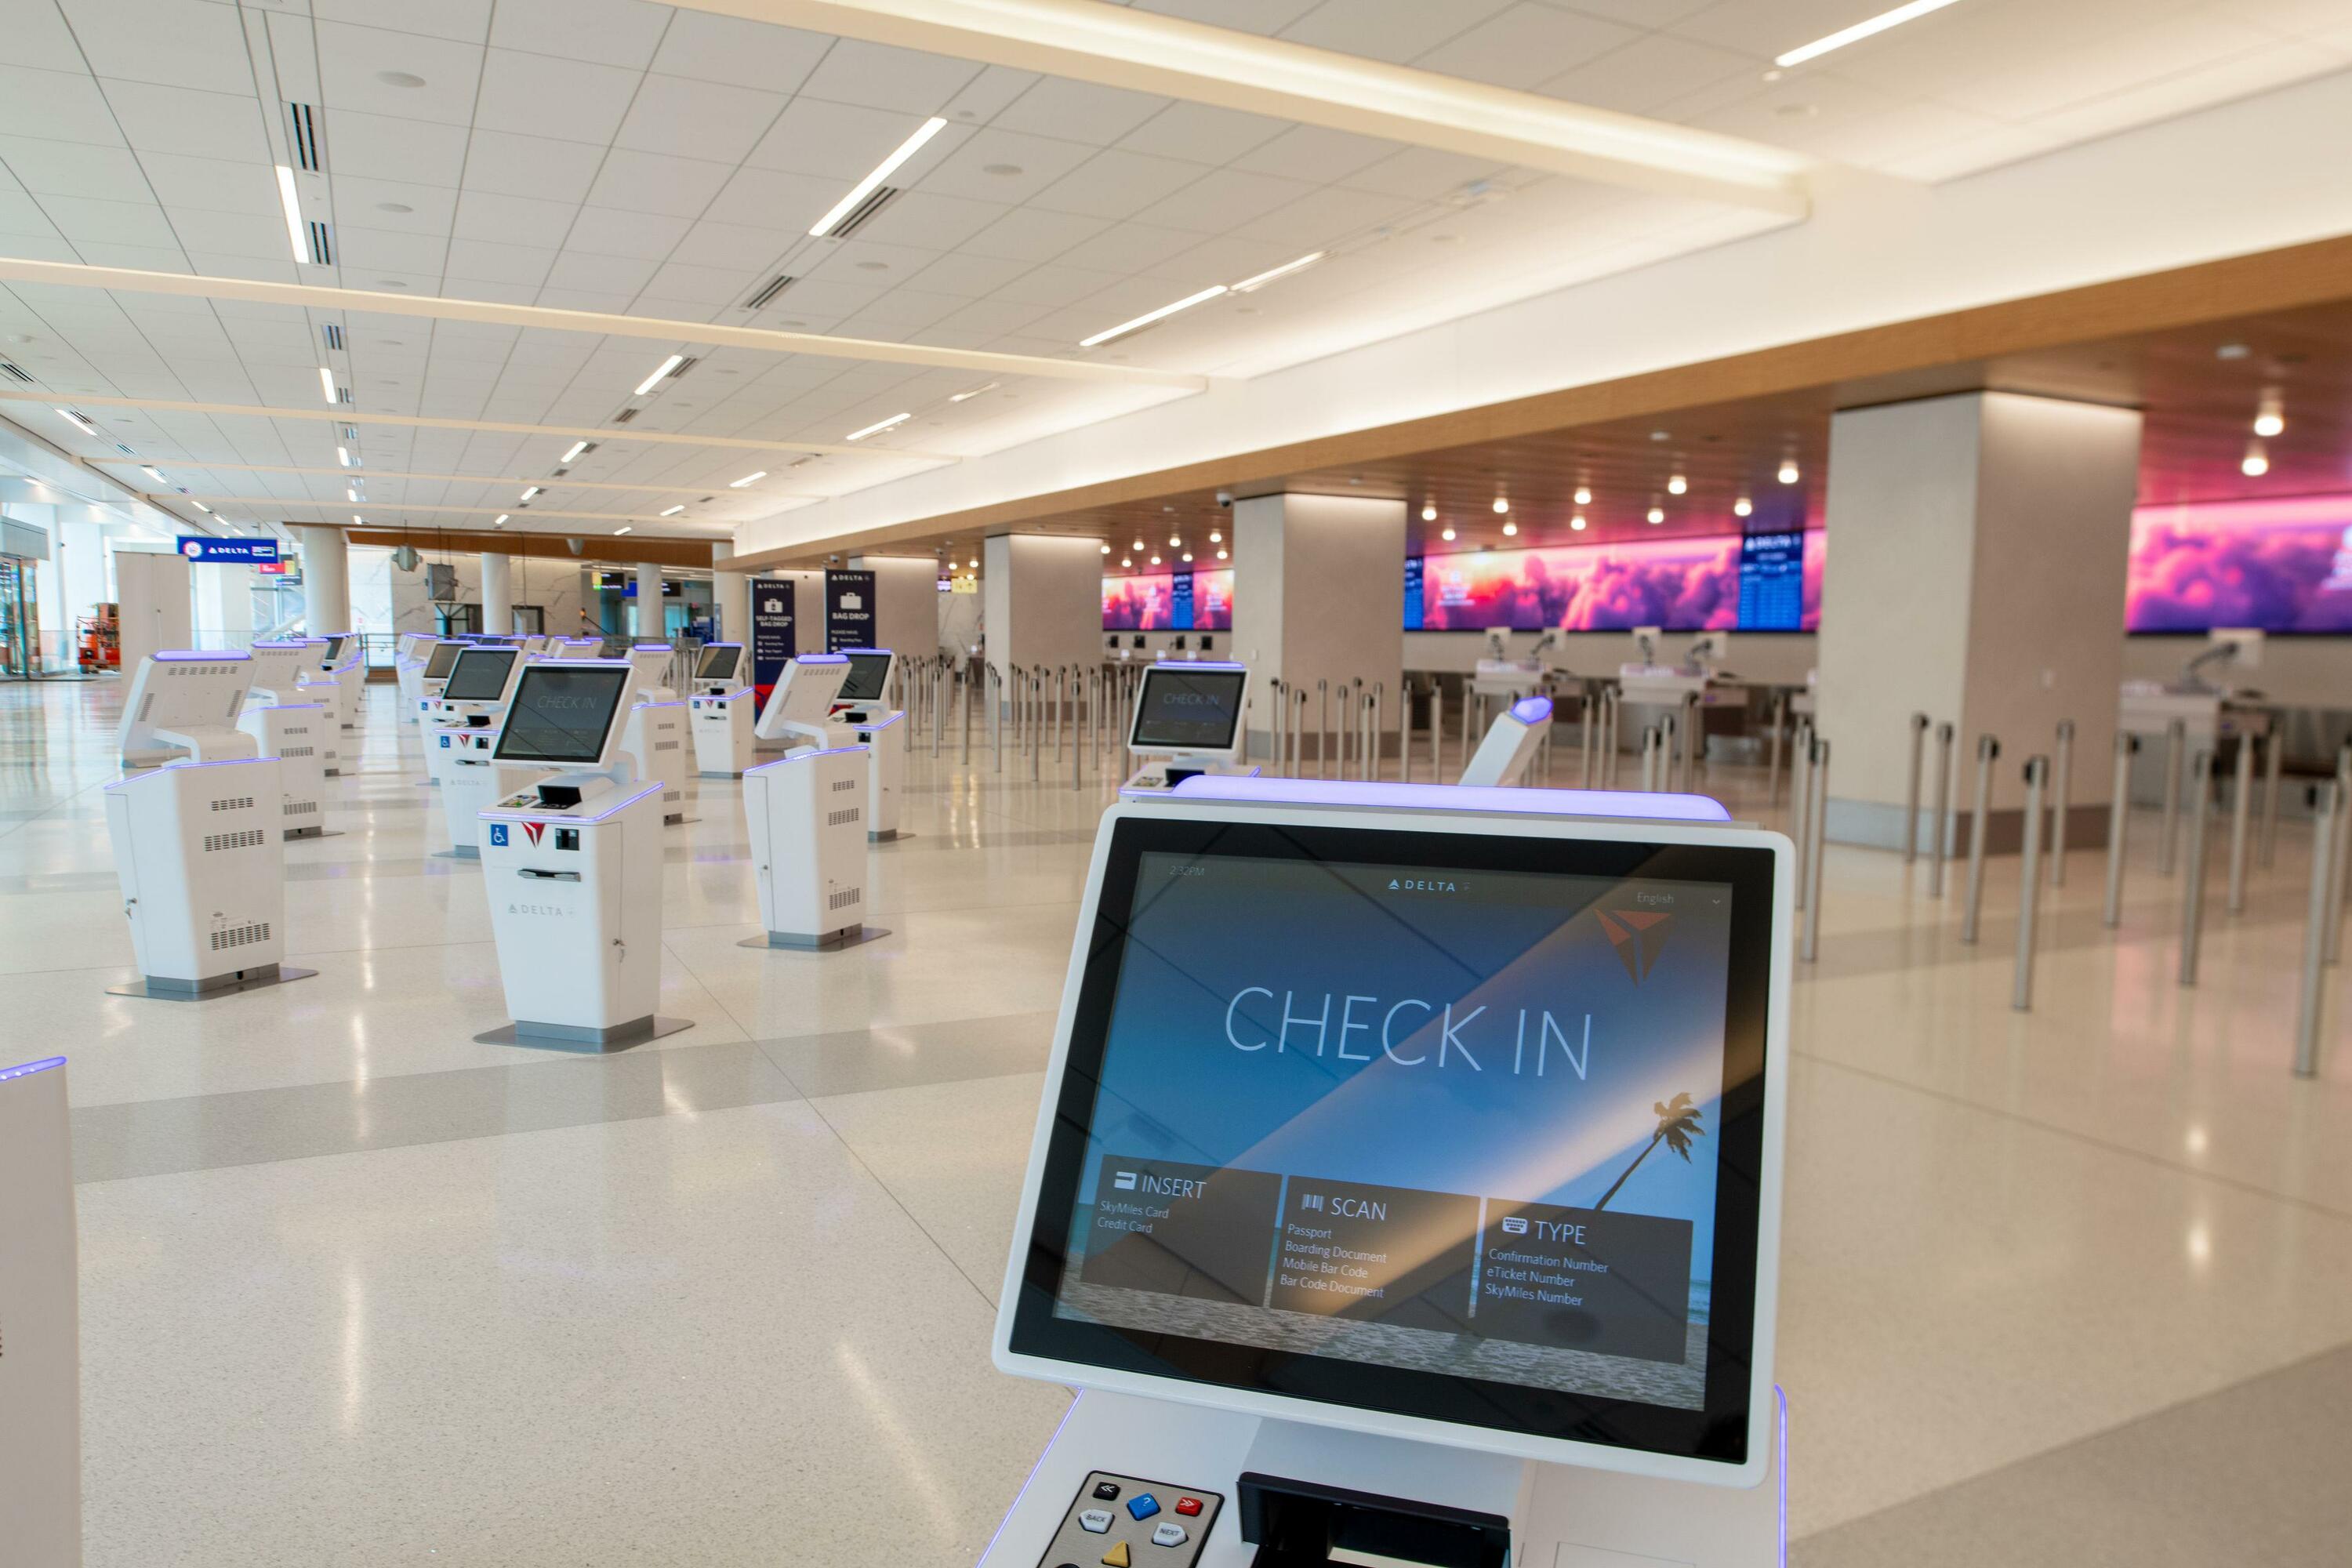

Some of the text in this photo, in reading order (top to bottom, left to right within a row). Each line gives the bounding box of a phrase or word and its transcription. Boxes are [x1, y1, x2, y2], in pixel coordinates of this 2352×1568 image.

[537, 695, 598, 710] CHECK IN
[1164, 694, 1218, 704] CHECK IN
[1404, 880, 1456, 892] DELTA
[1637, 891, 1675, 906] English
[521, 904, 563, 916] DELTA
[1225, 986, 1592, 1081] CHECK IN
[1142, 1174, 1207, 1200] INSERT
[1099, 1200, 1170, 1219] SkyMiles Card
[1330, 1197, 1387, 1221] SCAN
[1098, 1217, 1153, 1234] Credit Card
[1287, 1223, 1332, 1240] Passport
[1534, 1220, 1587, 1245] TYPE
[1285, 1240, 1387, 1264] Boarding Document
[1489, 1248, 1609, 1274] Confirmation Number
[1283, 1257, 1368, 1279] Mobile Bar Code
[1486, 1265, 1576, 1287] eTicket Number
[1279, 1274, 1385, 1299] Bar Code Document
[1485, 1283, 1583, 1307] SkyMiles Number
[1086, 1514, 1105, 1523] BACK
[1160, 1528, 1180, 1537] NEXT
